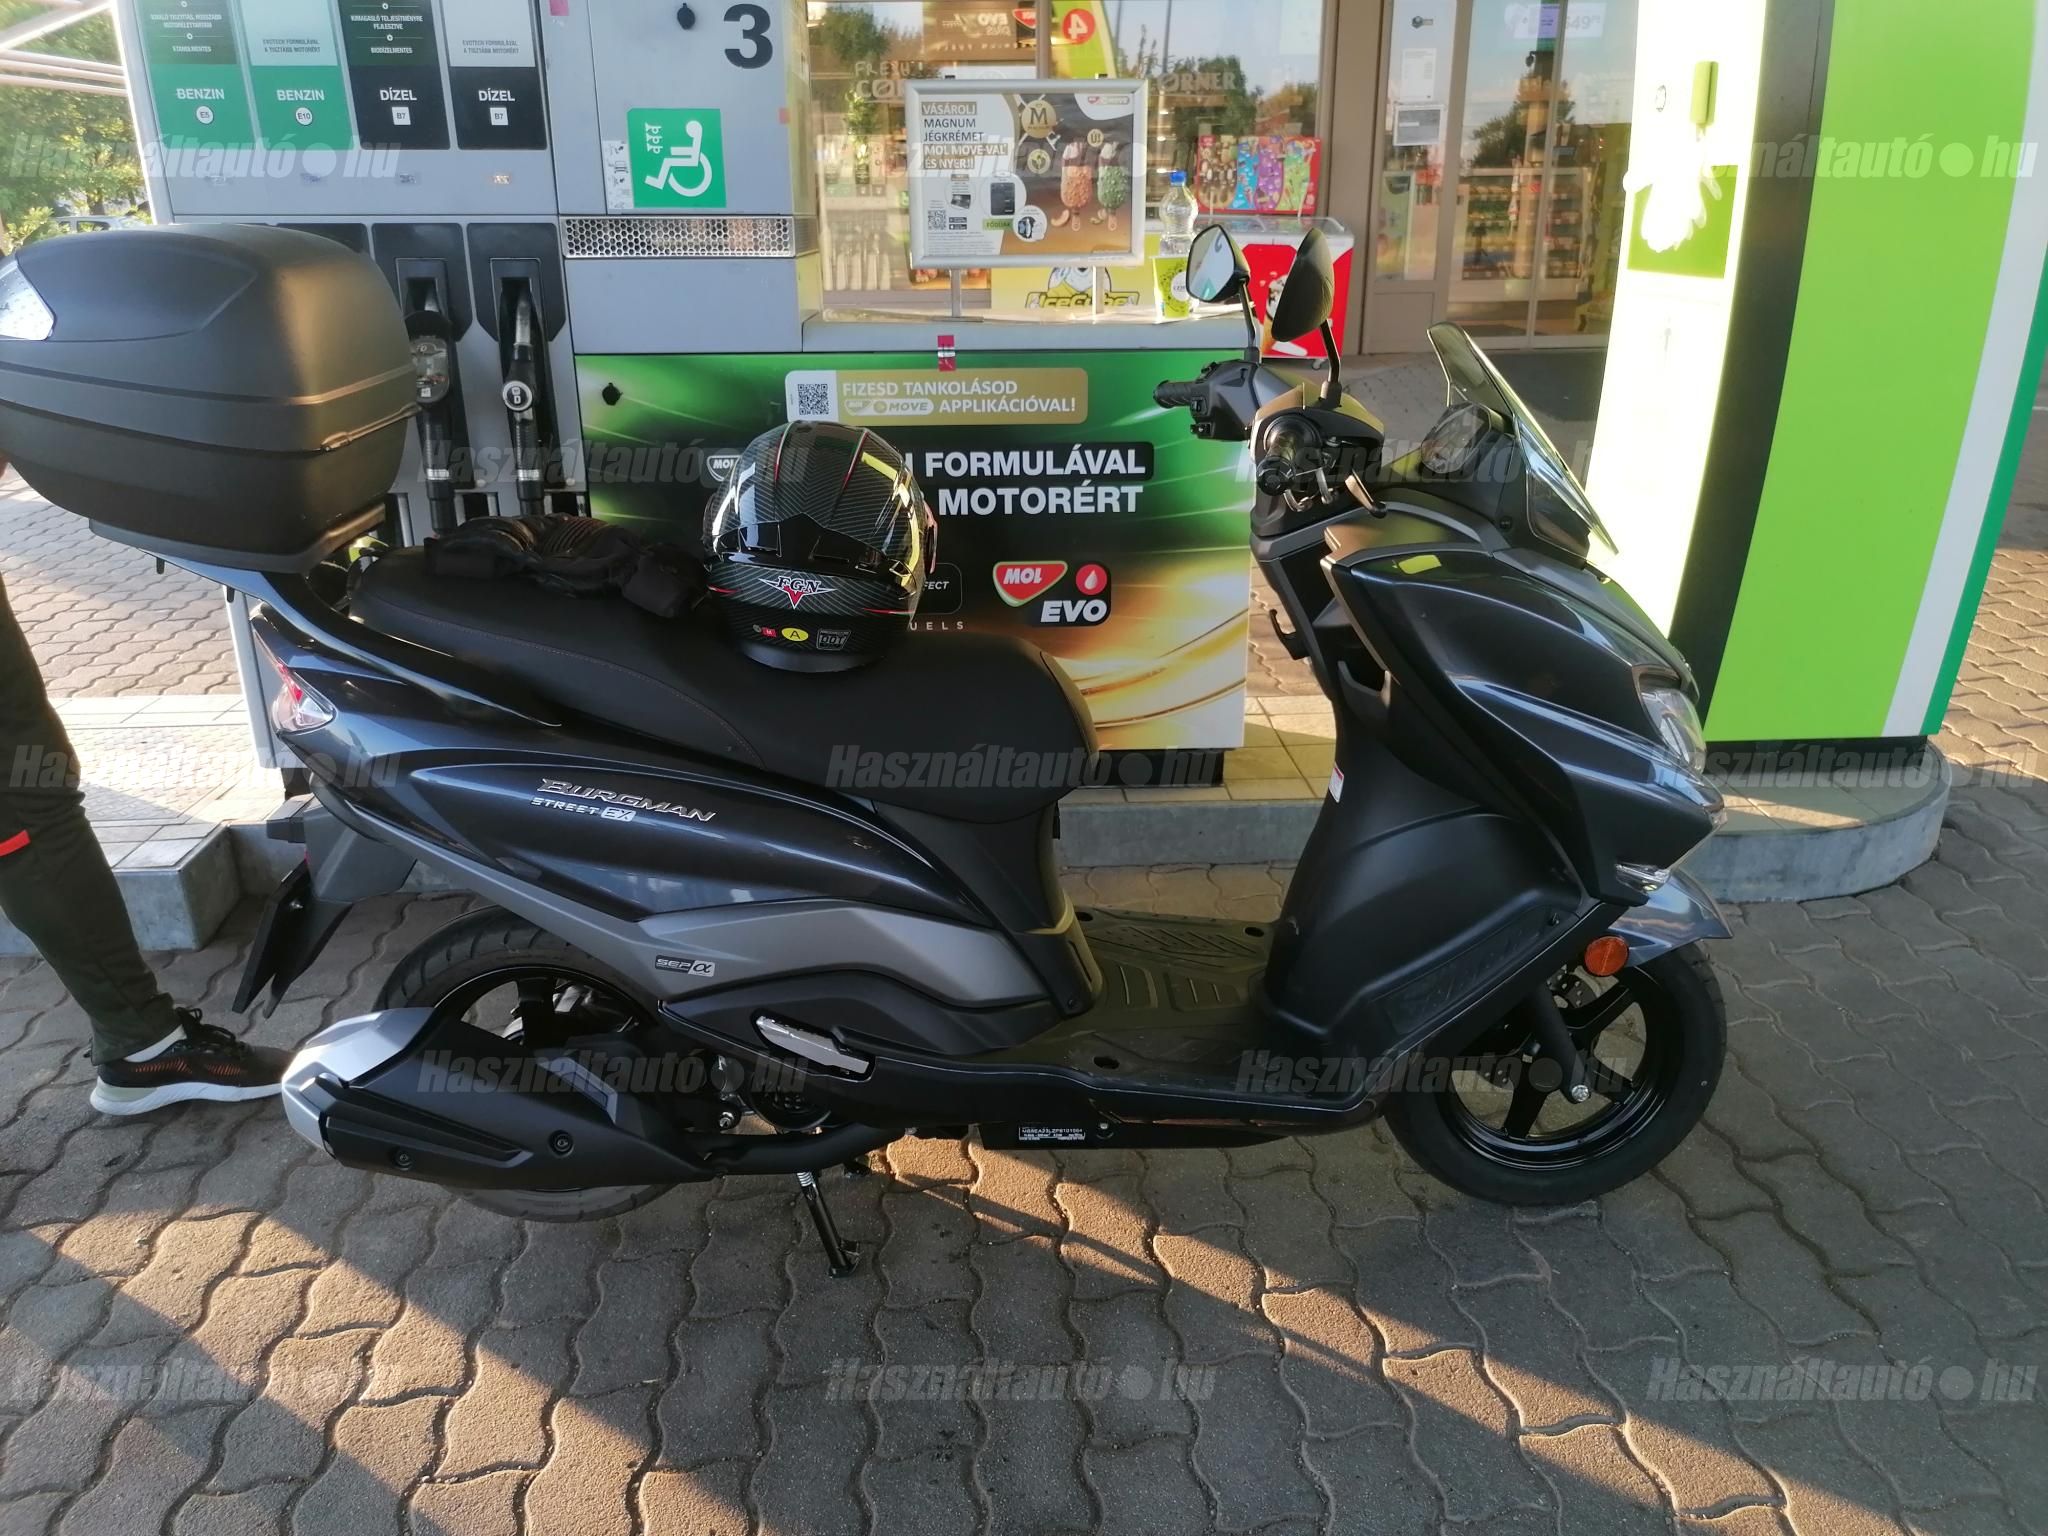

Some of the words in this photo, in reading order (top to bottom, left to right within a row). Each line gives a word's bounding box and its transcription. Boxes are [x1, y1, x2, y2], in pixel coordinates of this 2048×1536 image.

[722, 3, 774, 69] 3
[176, 88, 225, 100] BENZIN
[276, 89, 326, 101] BENZIN
[379, 87, 418, 101] DÍZEL
[478, 88, 516, 102] DÍZEL
[199, 111, 211, 119] E5
[297, 112, 312, 120] E10
[396, 112, 407, 120] B7
[494, 112, 505, 120] B7
[922, 102, 977, 116] VÁSÁROLJ
[923, 118, 977, 129] MAGNUM
[923, 130, 985, 142] JÉGKRÉMET
[842, 382, 898, 396] FIZESD
[903, 377, 1018, 396] TANKOLÁSOD
[888, 402, 929, 412] MOVE
[938, 396, 1077, 413] APPLIKÁCIÓVAL!
[925, 443, 1147, 478] FORMULÁVAL
[937, 479, 1144, 516] MOTORÉRT
[1003, 567, 1043, 585] MOL
[1040, 599, 1109, 623] EVO
[530, 797, 600, 815] STREET
[537, 778, 717, 822] BURGMAN
